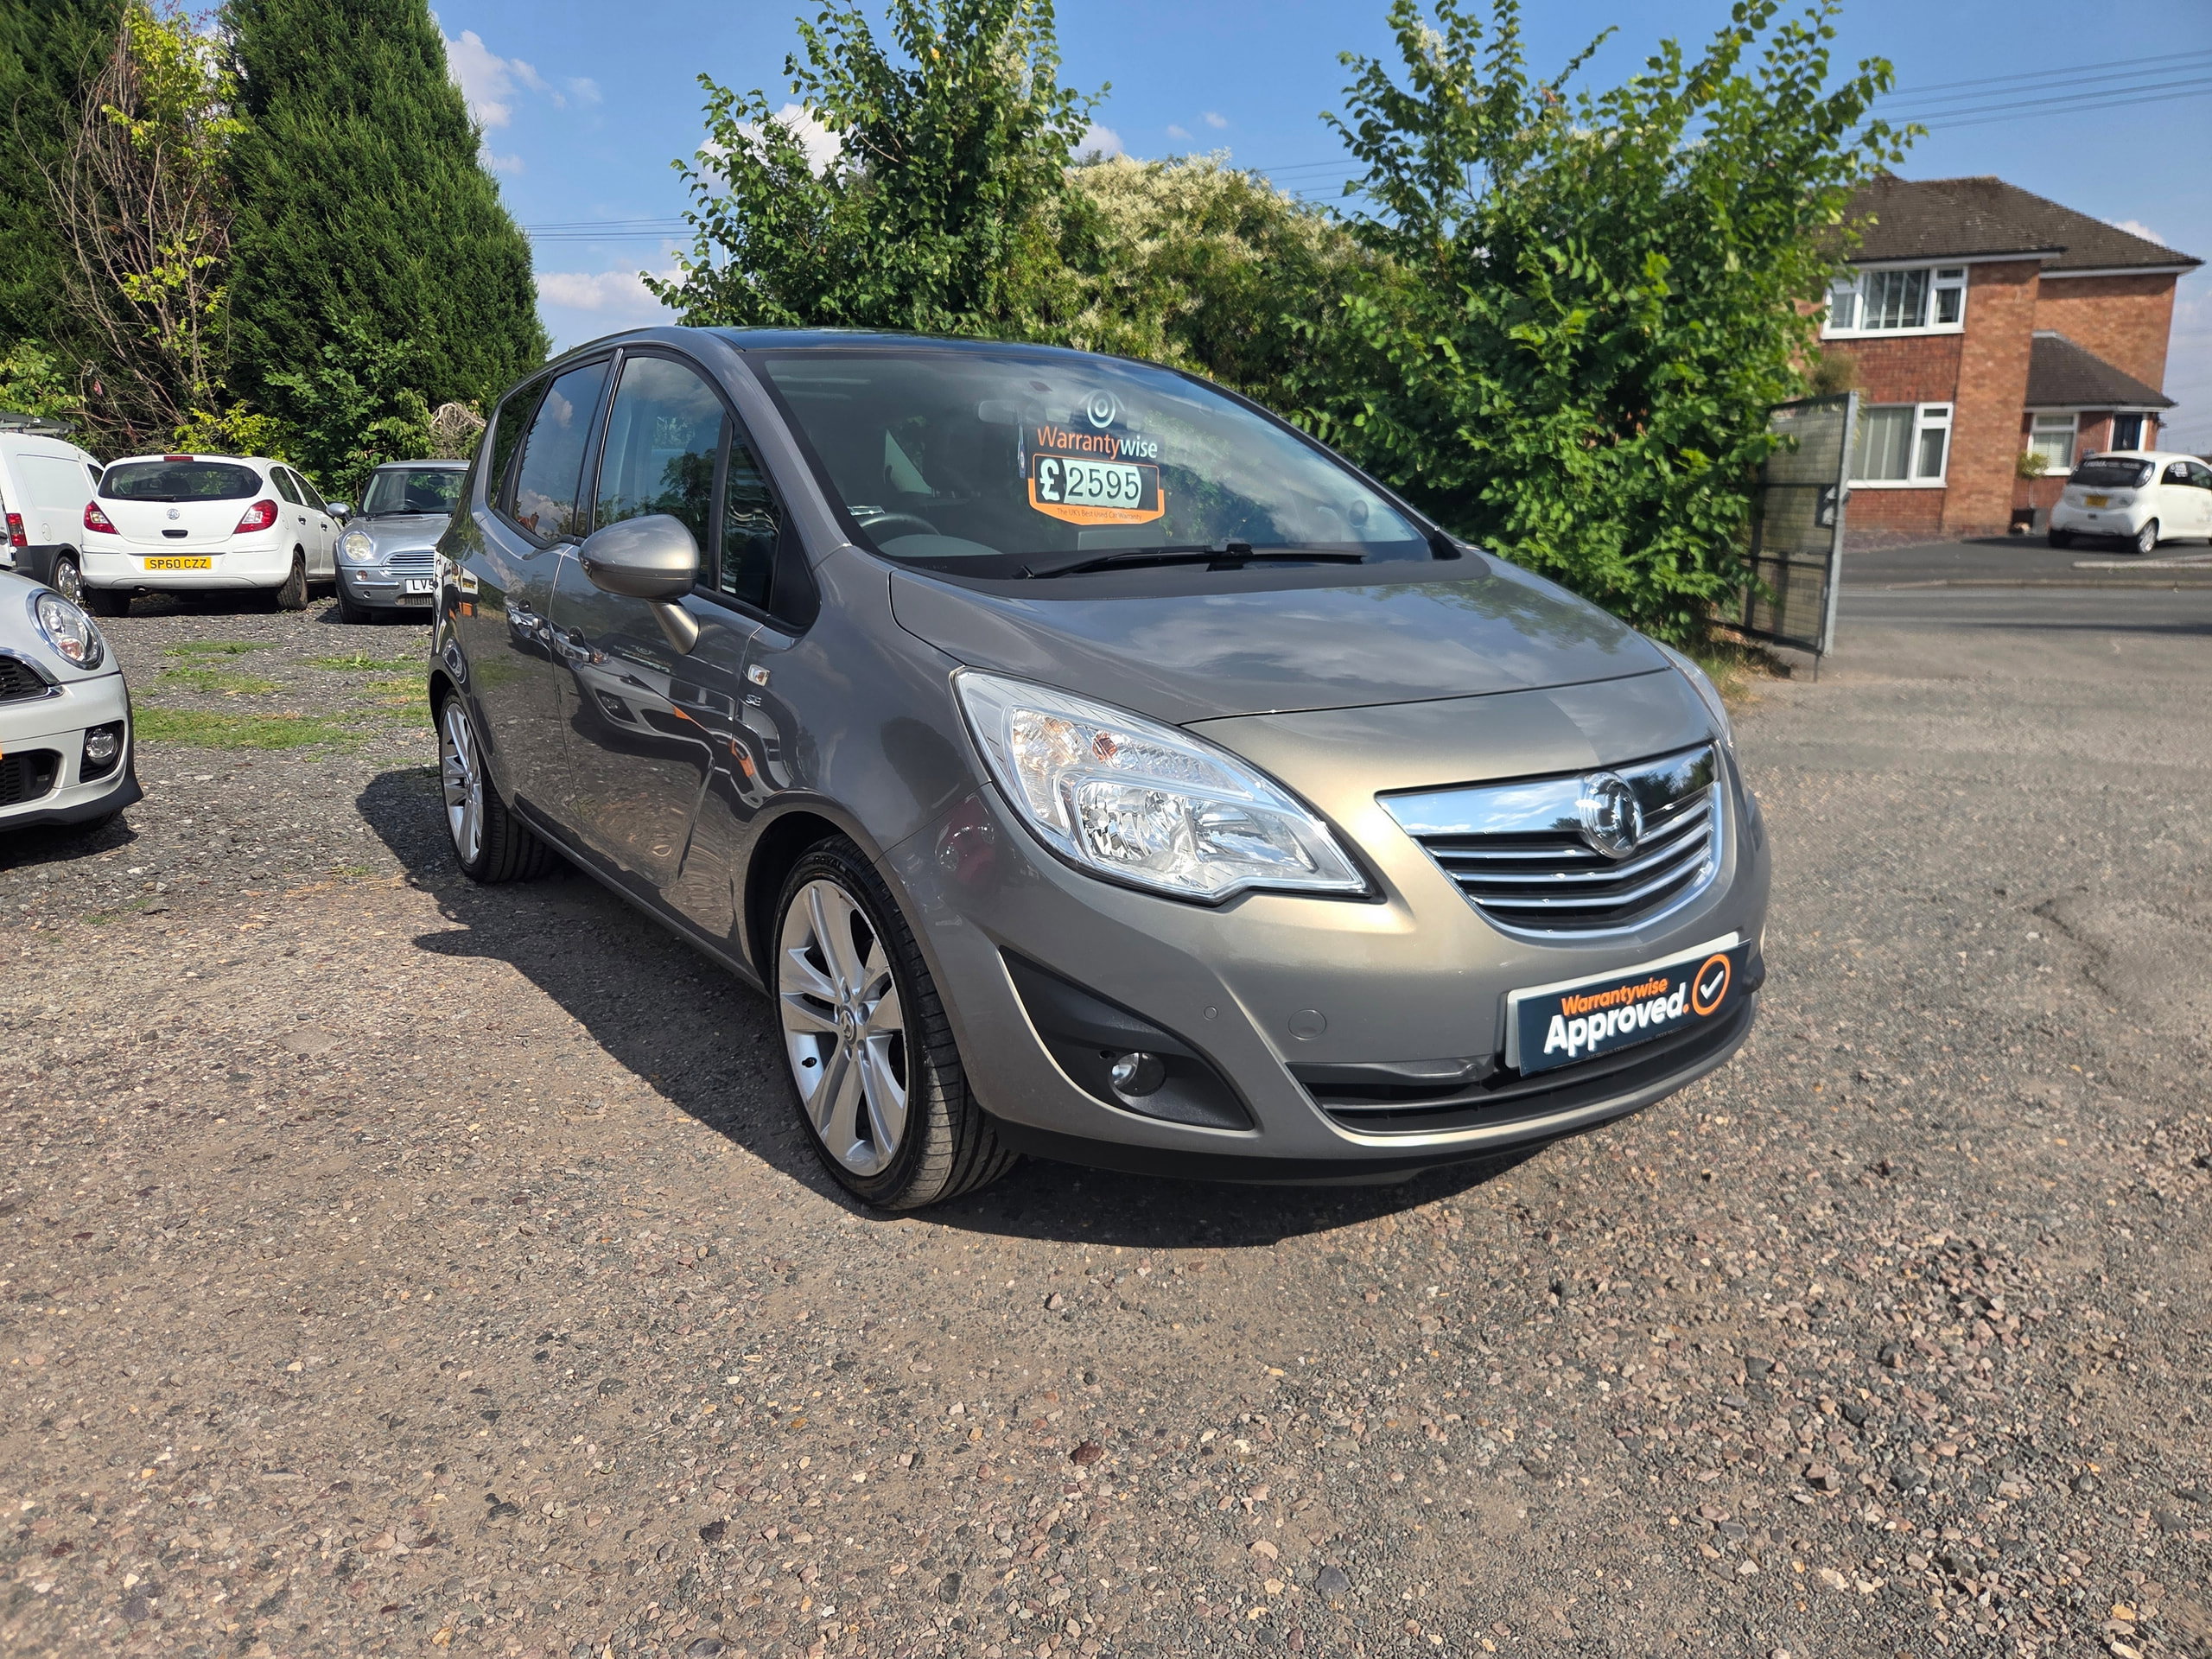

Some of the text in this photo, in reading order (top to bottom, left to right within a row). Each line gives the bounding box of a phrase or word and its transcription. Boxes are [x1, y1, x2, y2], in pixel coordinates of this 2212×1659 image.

[1038, 426, 1158, 460] Warrantywise
[1039, 459, 1139, 501] £2595
[1069, 508, 1080, 517] UK's
[1118, 512, 1142, 521] Warranty
[149, 559, 207, 569] SP60 CZZ
[745, 694, 761, 707] SE
[1561, 976, 1670, 1017] Warrantywise
[1543, 982, 1690, 1058] Approved.
